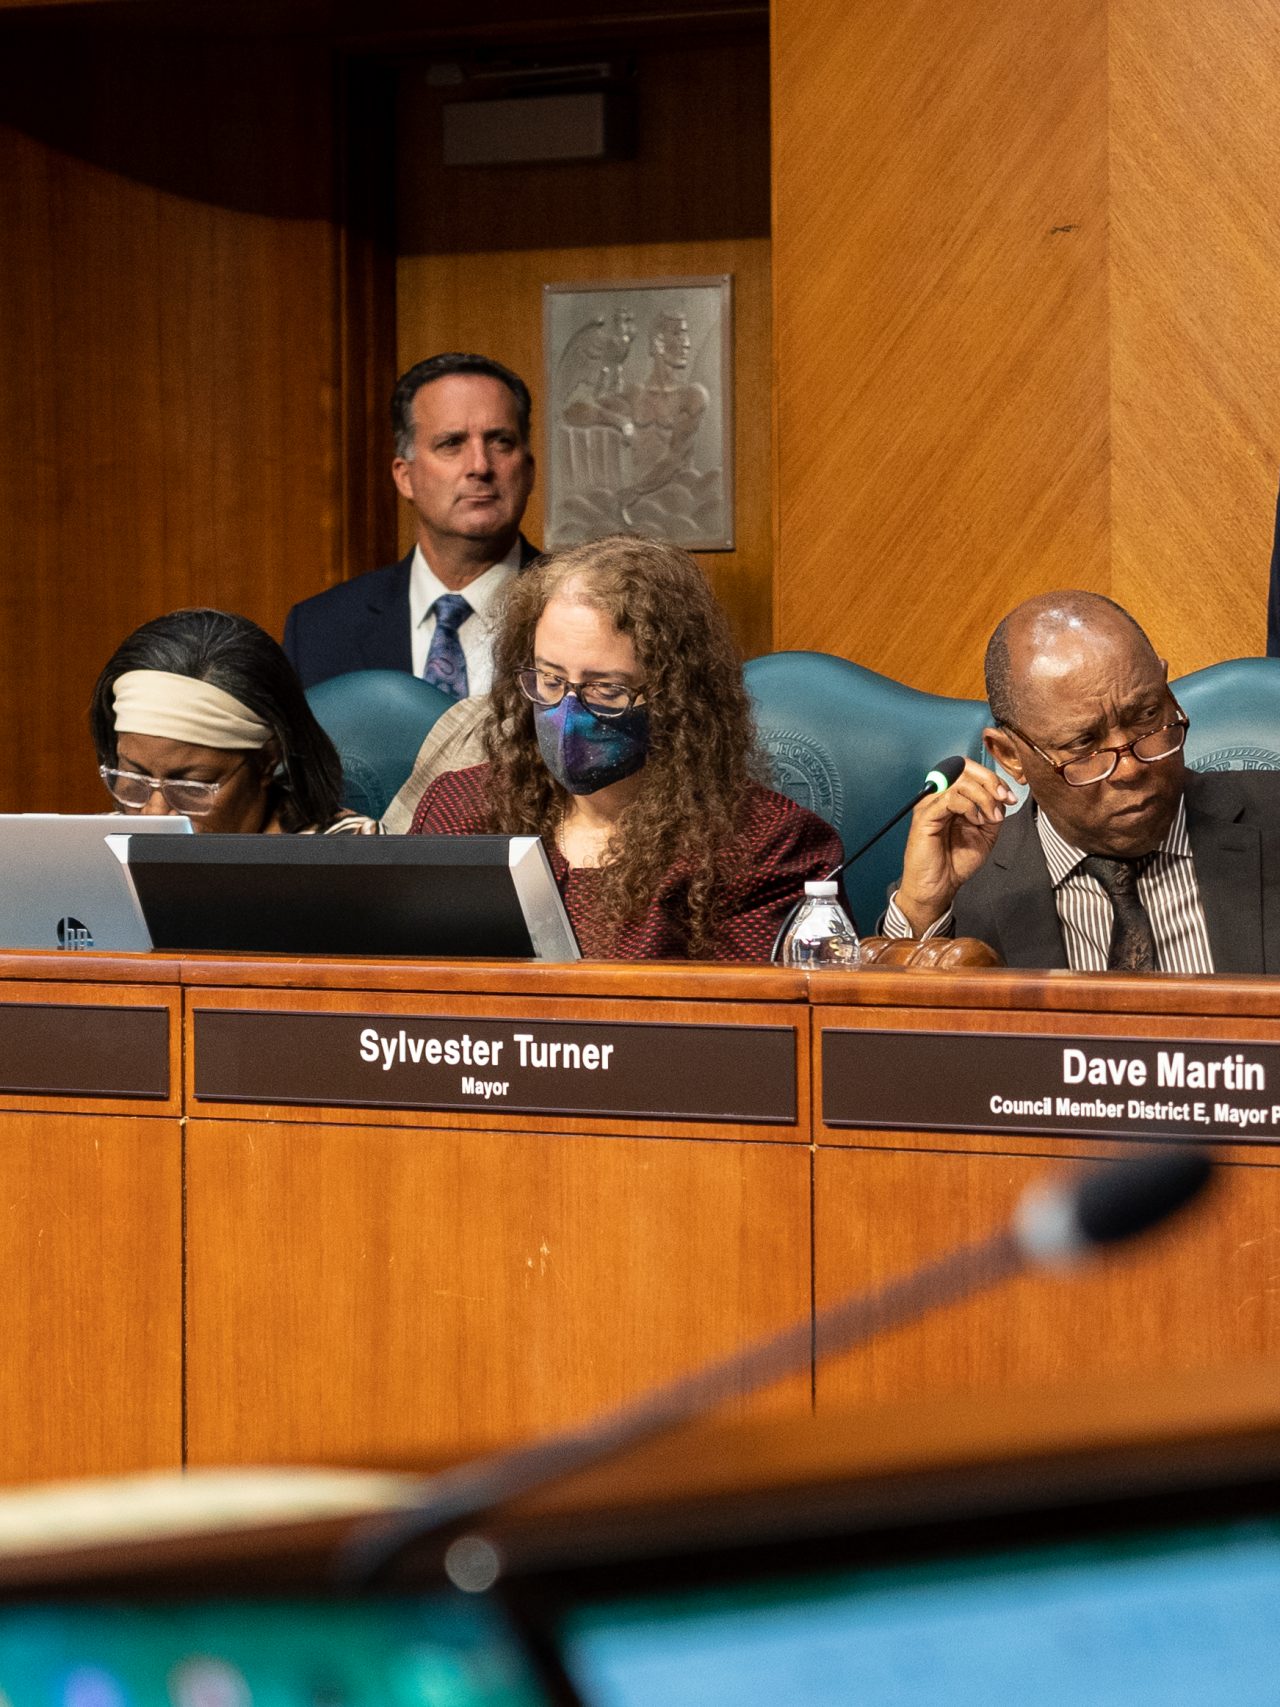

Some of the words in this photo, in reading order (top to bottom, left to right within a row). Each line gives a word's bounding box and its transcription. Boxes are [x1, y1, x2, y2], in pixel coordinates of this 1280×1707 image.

[359, 1028, 504, 1071] Sylvester
[512, 1033, 614, 1071] Turner
[461, 1076, 510, 1100] Mayor
[1062, 1048, 1148, 1086] Dave
[1156, 1051, 1266, 1091] Martin
[989, 1094, 1052, 1116] Council
[1055, 1097, 1125, 1119] Member
[1127, 1099, 1191, 1122] District
[1193, 1102, 1211, 1125] E,
[1213, 1103, 1269, 1128] Mayor
